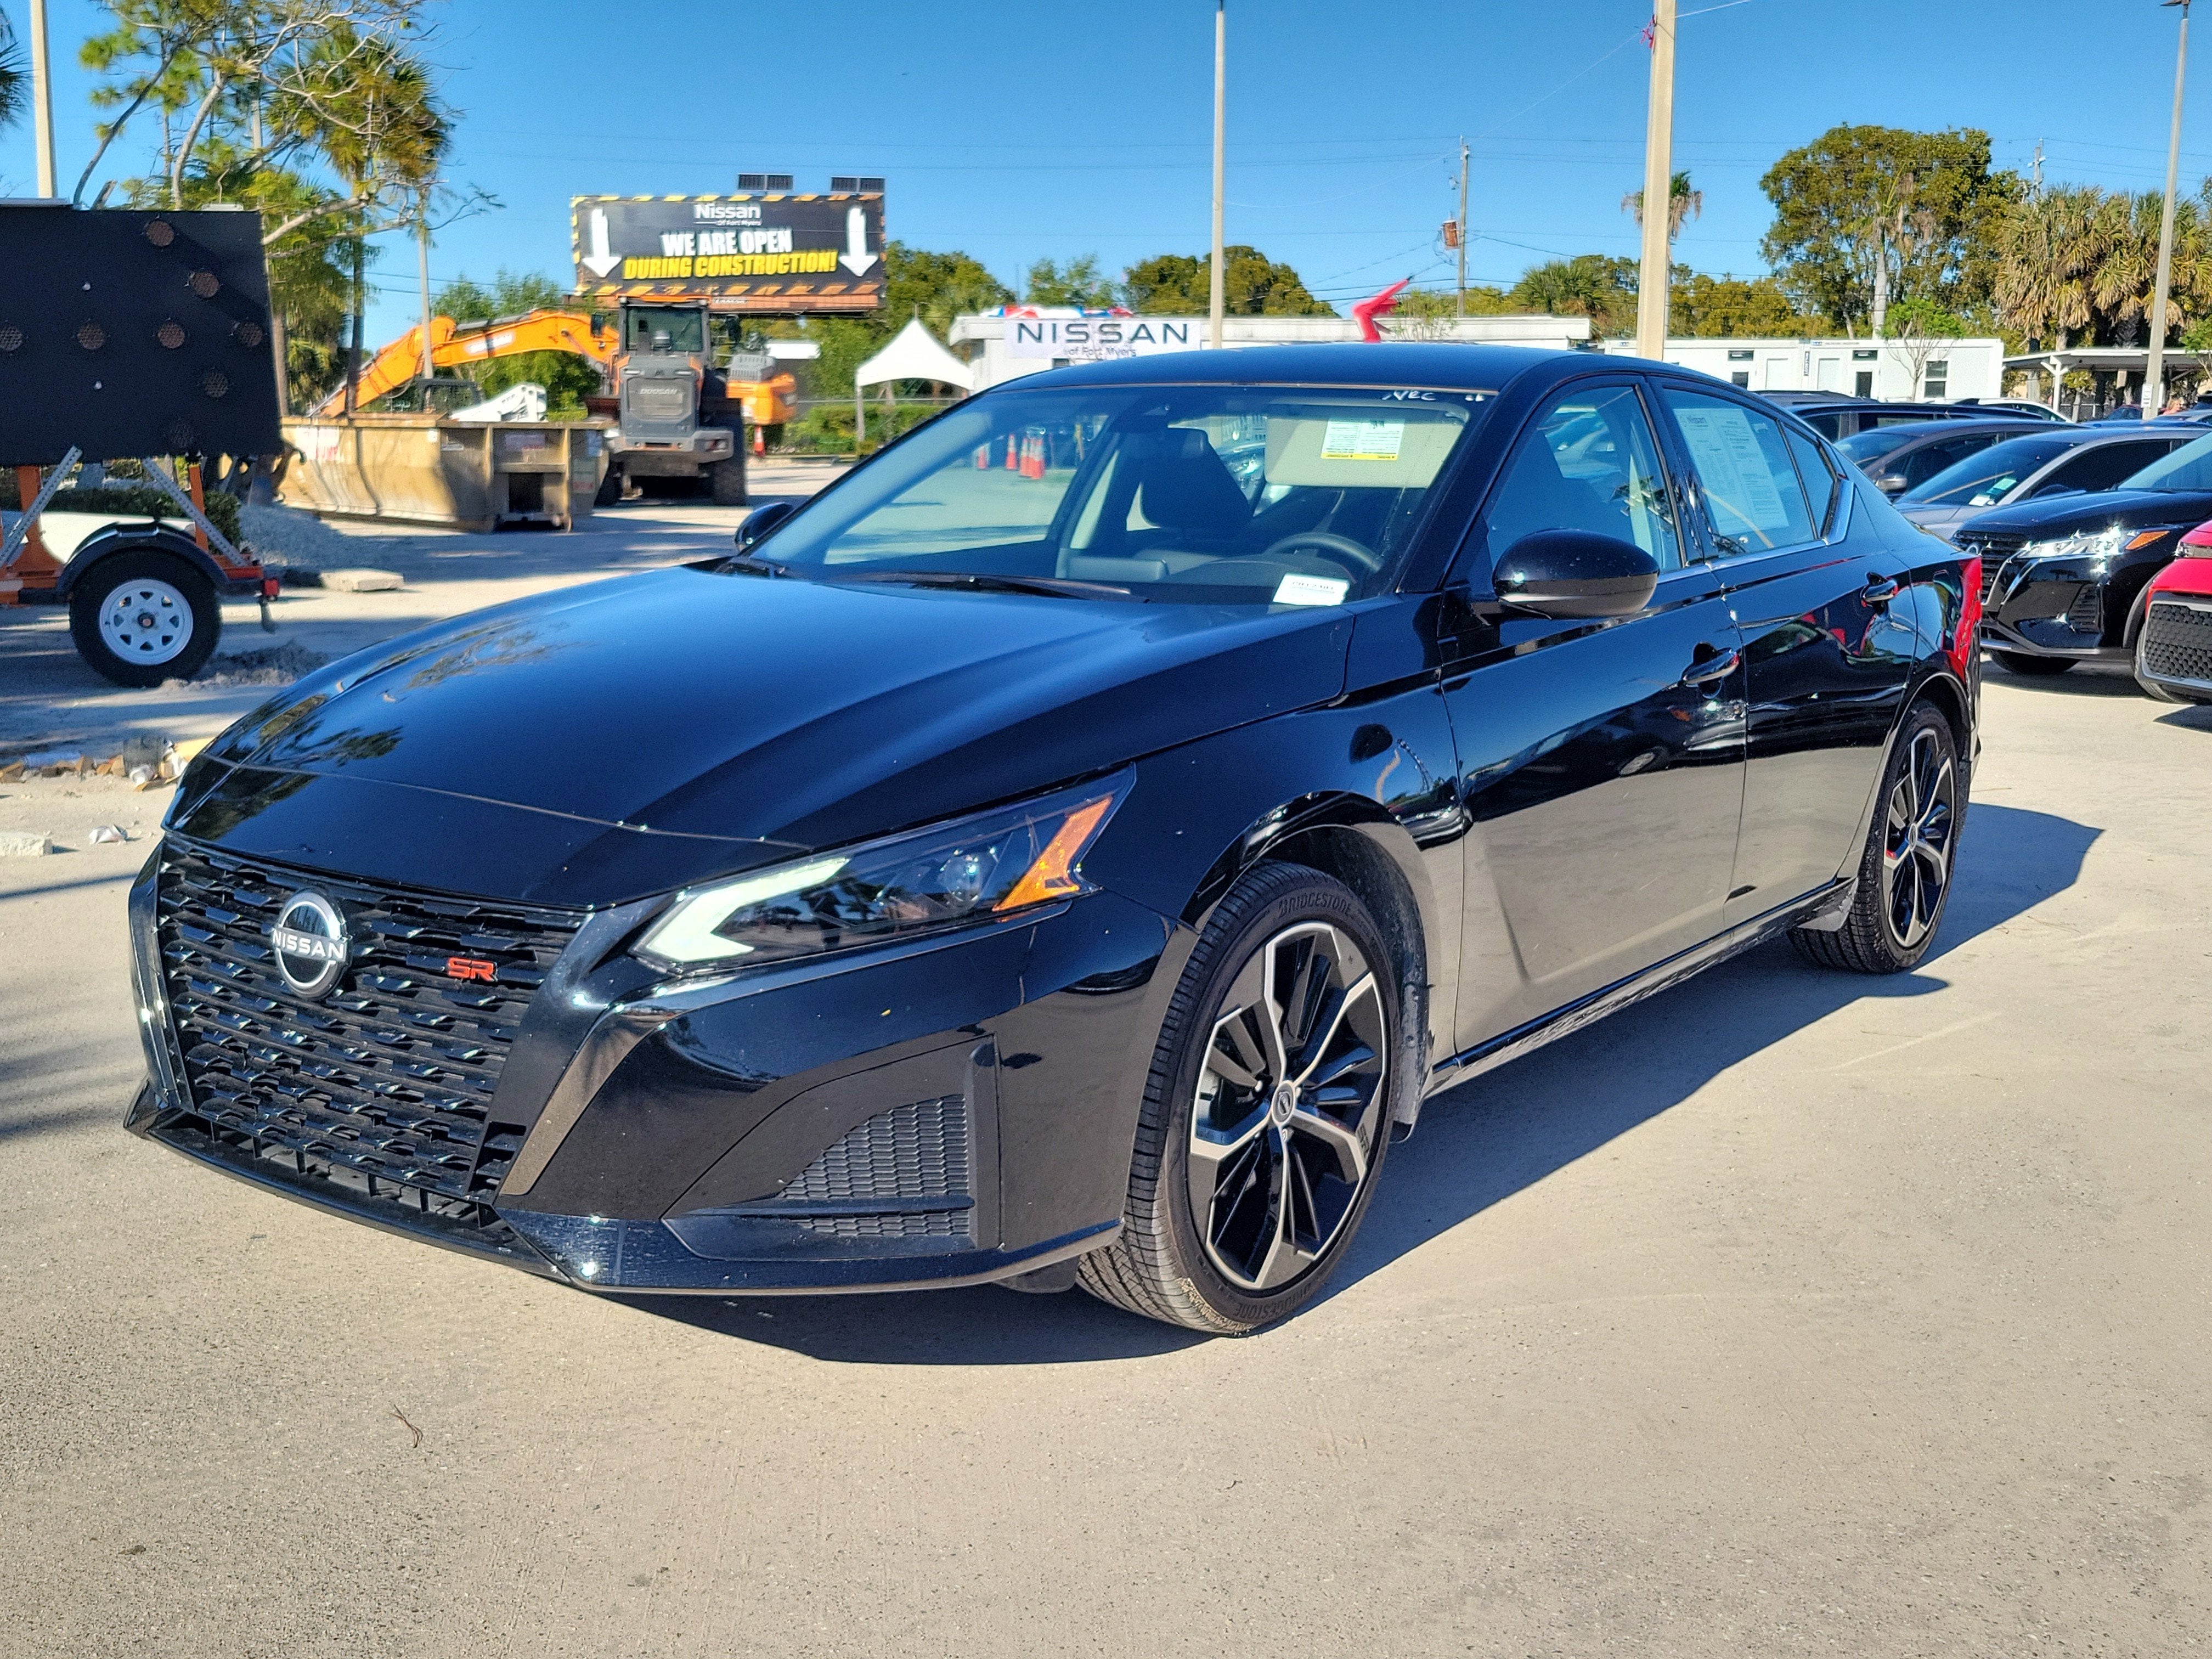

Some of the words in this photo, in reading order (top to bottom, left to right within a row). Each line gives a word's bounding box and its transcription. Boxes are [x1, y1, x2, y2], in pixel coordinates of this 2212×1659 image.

[694, 203, 761, 219] Nissan
[661, 233, 696, 257] WE
[698, 230, 738, 256] ARE
[740, 227, 793, 255] OPEN
[623, 256, 692, 279] DURING
[694, 250, 838, 277] CONSTRUCTION!
[1018, 323, 1188, 344] NISSAN
[1105, 347, 1136, 357] Myers
[1278, 892, 1351, 917] BRIDGESTONE
[273, 929, 344, 959] NISSAN
[448, 957, 495, 982] SR
[1357, 1122, 1370, 1159] SR
